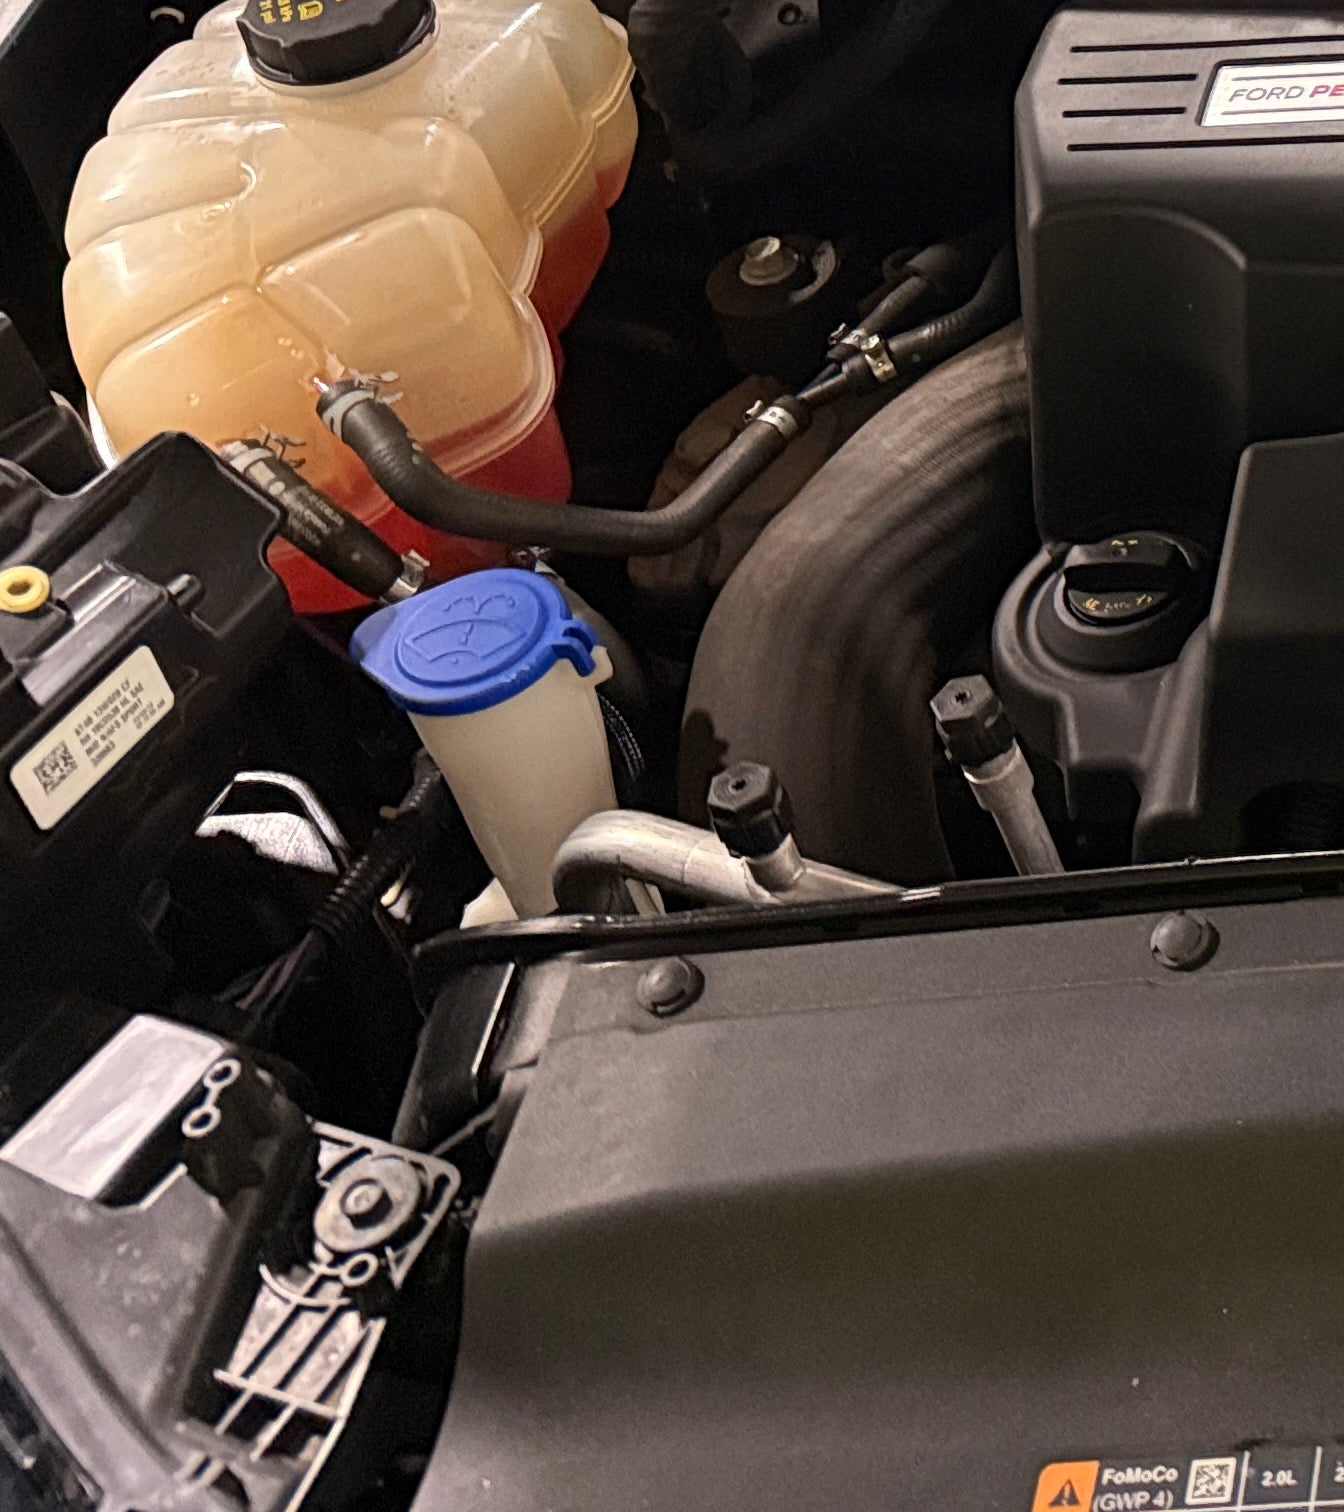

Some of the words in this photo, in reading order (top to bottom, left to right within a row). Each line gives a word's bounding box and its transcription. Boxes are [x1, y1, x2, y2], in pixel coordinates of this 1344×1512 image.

[1229, 86, 1304, 102] FORD
[1102, 1465, 1178, 1486] FoMoCo
[1262, 1470, 1298, 1487] 2.0L
[1094, 1491, 1151, 1512] (GWP
[1152, 1489, 1174, 1509] 4)
